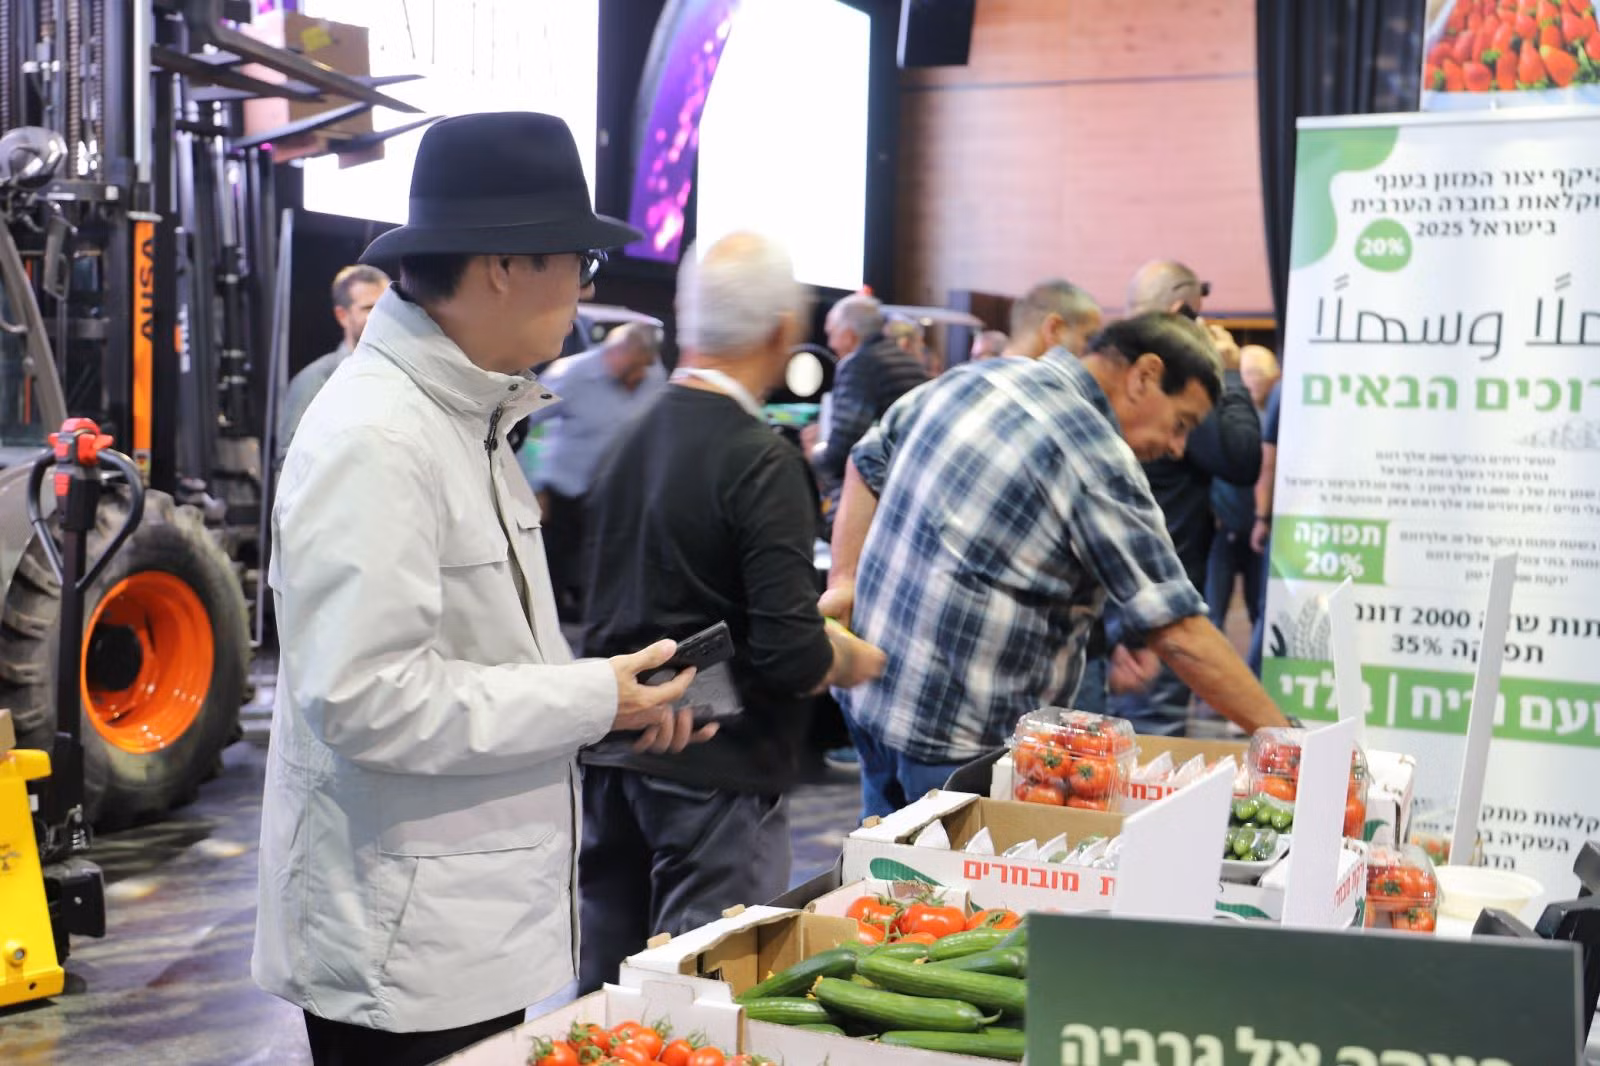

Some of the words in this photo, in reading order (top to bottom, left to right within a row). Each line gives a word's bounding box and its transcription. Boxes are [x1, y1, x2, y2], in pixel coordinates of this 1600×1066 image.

[1375, 173, 1427, 193] בענף
[1434, 171, 1494, 192] המזון
[1501, 169, 1545, 187] יצור
[1351, 197, 1432, 214] הערבית
[1438, 195, 1509, 212] בחברה
[1416, 221, 1463, 237] 2025
[1470, 217, 1556, 237] בישראל
[1360, 238, 1406, 257] 20%
[1302, 373, 1459, 410] הבאים
[1294, 521, 1380, 549] תפוקה
[1303, 551, 1364, 577] 20%
[1411, 606, 1471, 629] 2000
[1391, 633, 1443, 657] 35%
[1452, 639, 1543, 664] תפקה
[1411, 685, 1506, 727] ויח
[1534, 810, 1600, 834] קלאות
[1500, 830, 1568, 852] השקיה
[962, 859, 1080, 893] מובחרים
